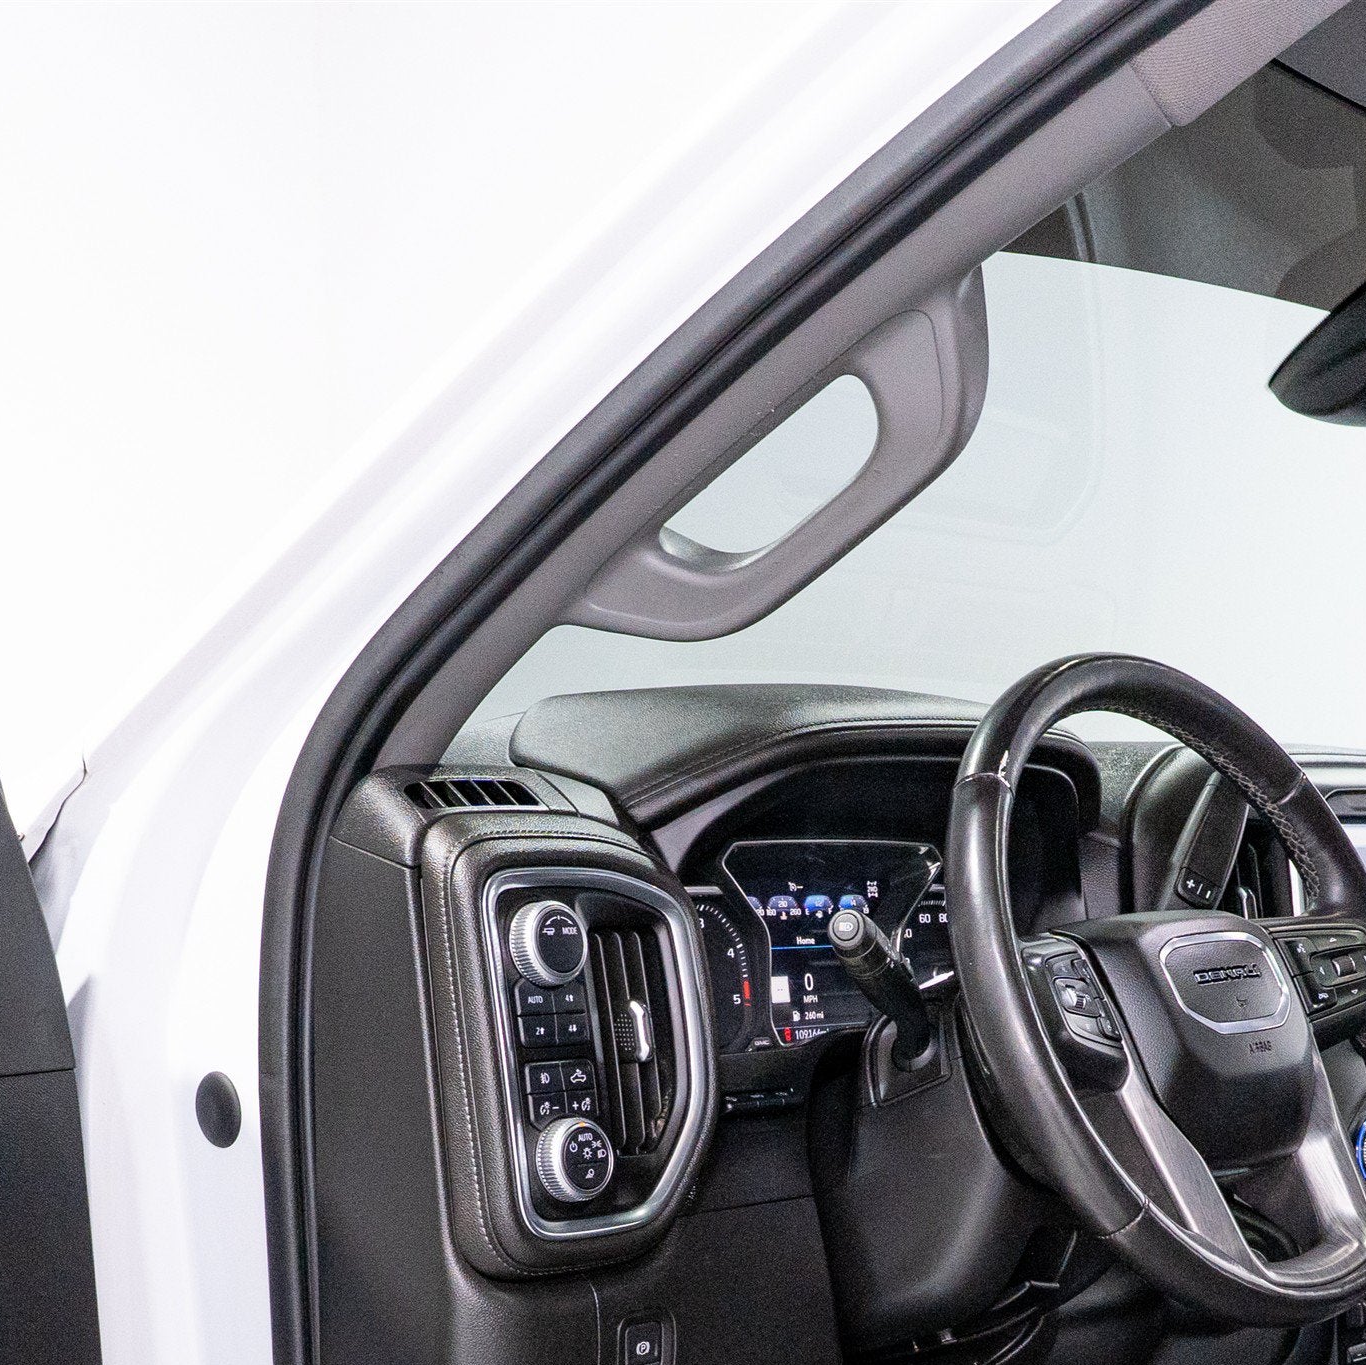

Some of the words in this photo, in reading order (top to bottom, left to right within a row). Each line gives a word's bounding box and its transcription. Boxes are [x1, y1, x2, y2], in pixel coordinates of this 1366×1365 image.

[699, 917, 705, 929] 3
[918, 913, 931, 924] 60
[561, 926, 578, 935] MODE
[796, 936, 816, 945] Home
[727, 947, 735, 959] 4
[1194, 963, 1262, 985] DENALI
[804, 973, 814, 991] 0
[527, 995, 544, 1004] AUTO
[733, 994, 742, 1005] 5
[803, 995, 819, 1004] MPH
[577, 1132, 594, 1142] AUTO
